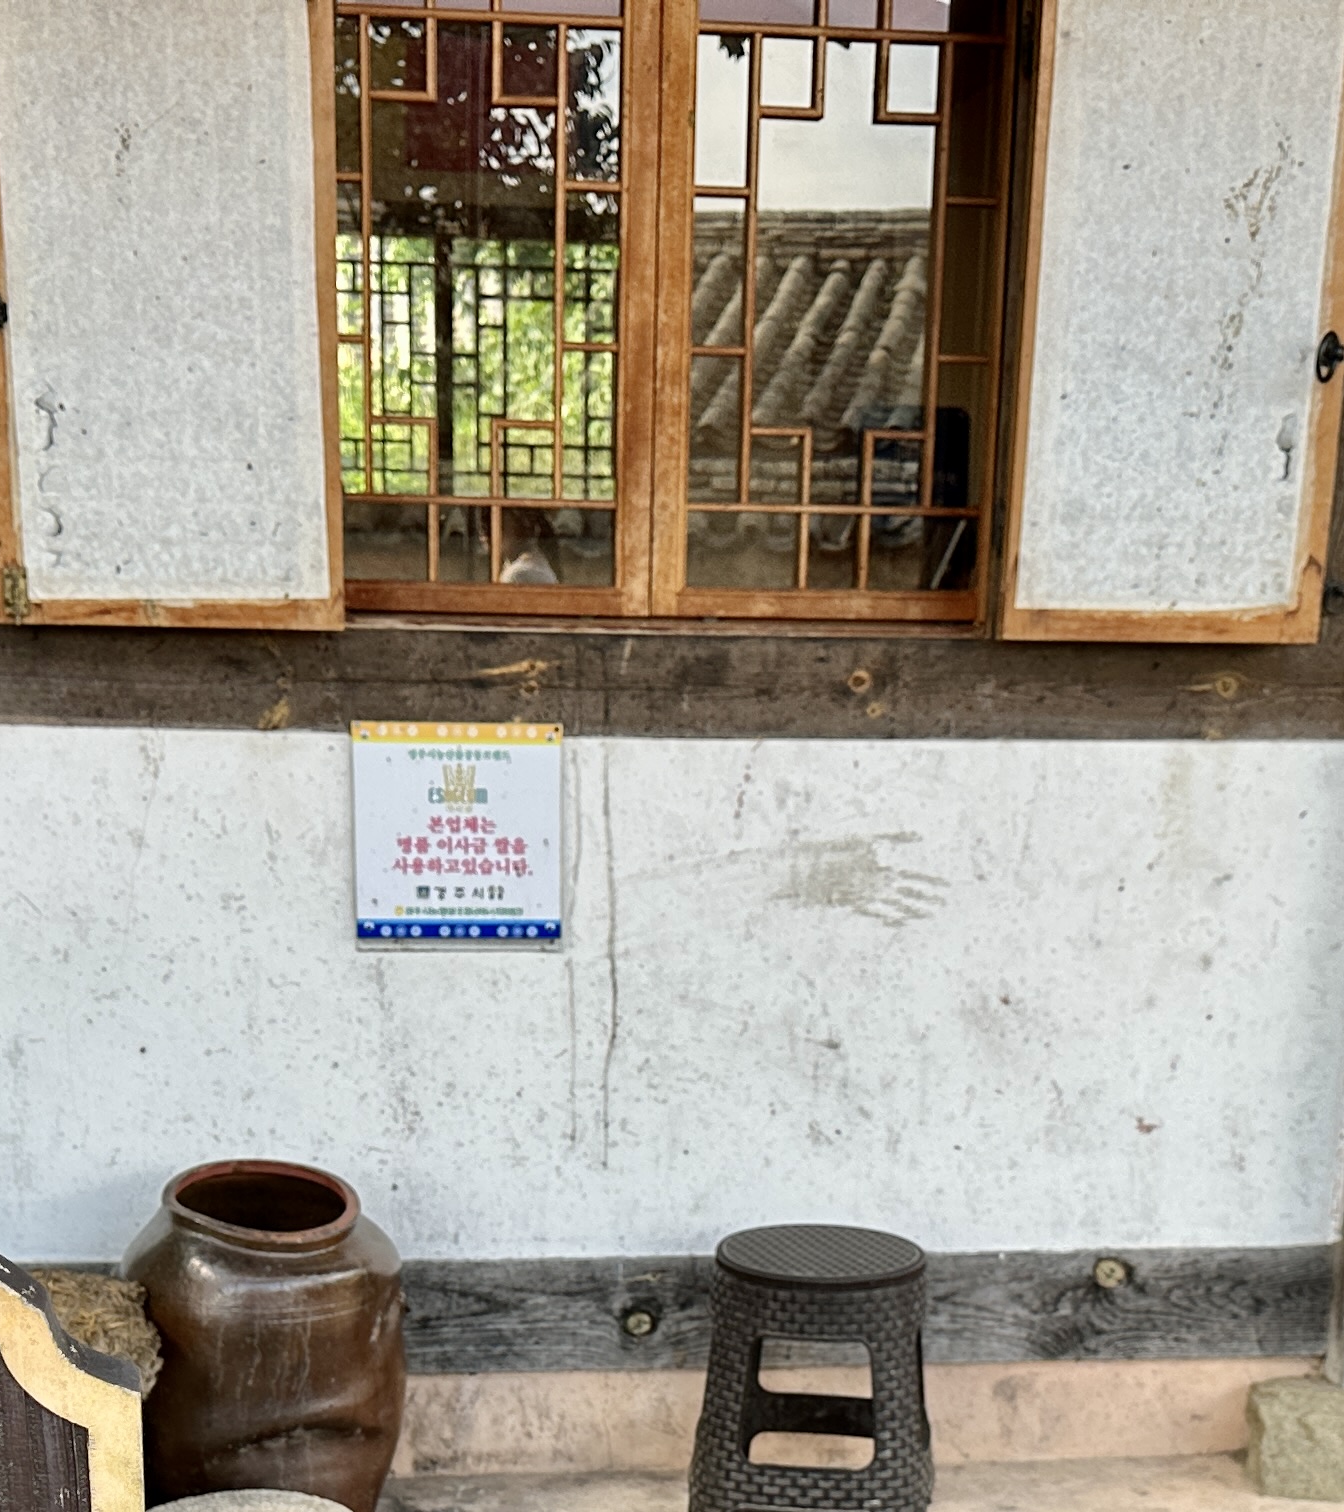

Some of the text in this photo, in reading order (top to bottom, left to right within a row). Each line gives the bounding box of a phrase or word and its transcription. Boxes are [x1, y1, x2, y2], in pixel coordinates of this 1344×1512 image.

[427, 815, 497, 835] 본업체는
[396, 836, 431, 855] 명품
[436, 836, 487, 856] 이사금
